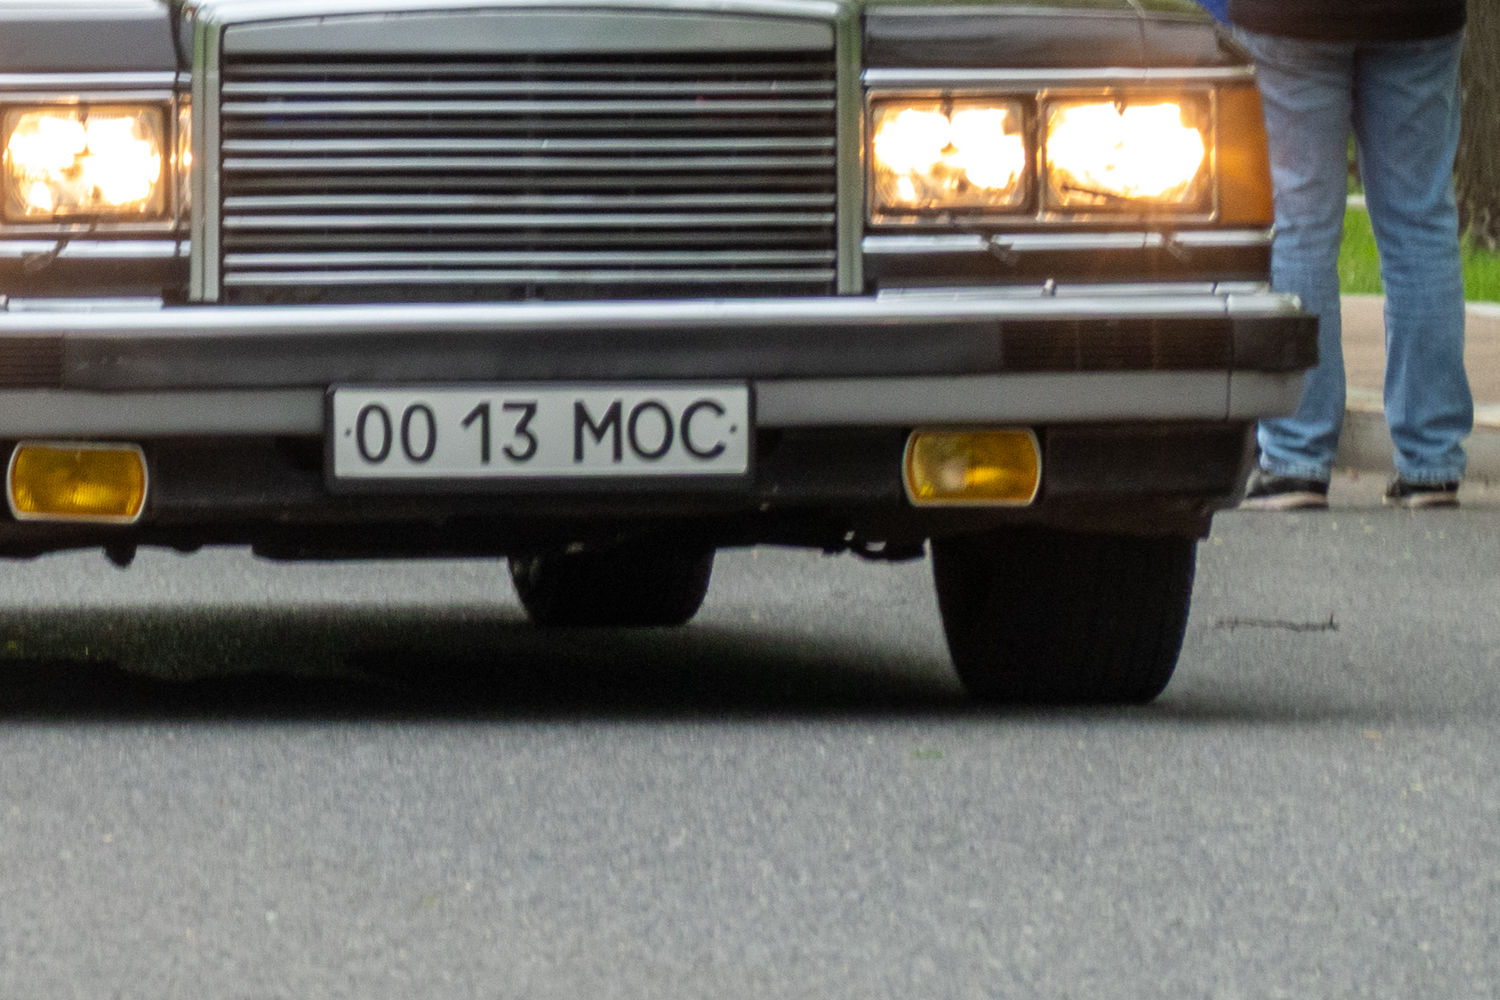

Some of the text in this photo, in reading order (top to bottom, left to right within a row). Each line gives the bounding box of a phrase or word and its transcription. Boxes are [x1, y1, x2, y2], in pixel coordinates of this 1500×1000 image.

[355, 400, 727, 464] 00 13 МОС
